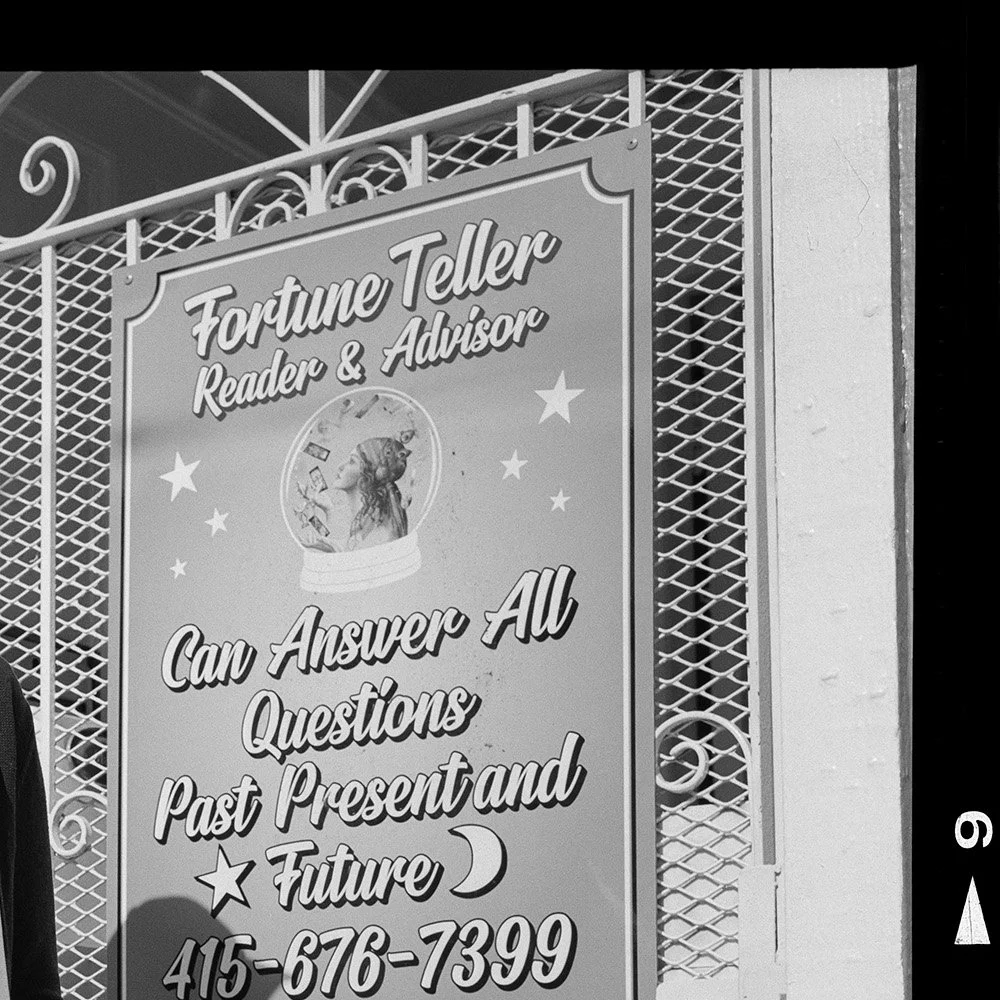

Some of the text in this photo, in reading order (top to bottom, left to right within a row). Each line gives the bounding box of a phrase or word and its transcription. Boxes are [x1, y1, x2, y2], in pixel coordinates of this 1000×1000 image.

[184, 217, 562, 360] Fortune Teller
[192, 304, 549, 421] Reader & Advisor
[161, 565, 578, 692] Can Answer All
[241, 676, 482, 765] Questions
[153, 731, 588, 846] Past Present and
[264, 840, 445, 911] Future
